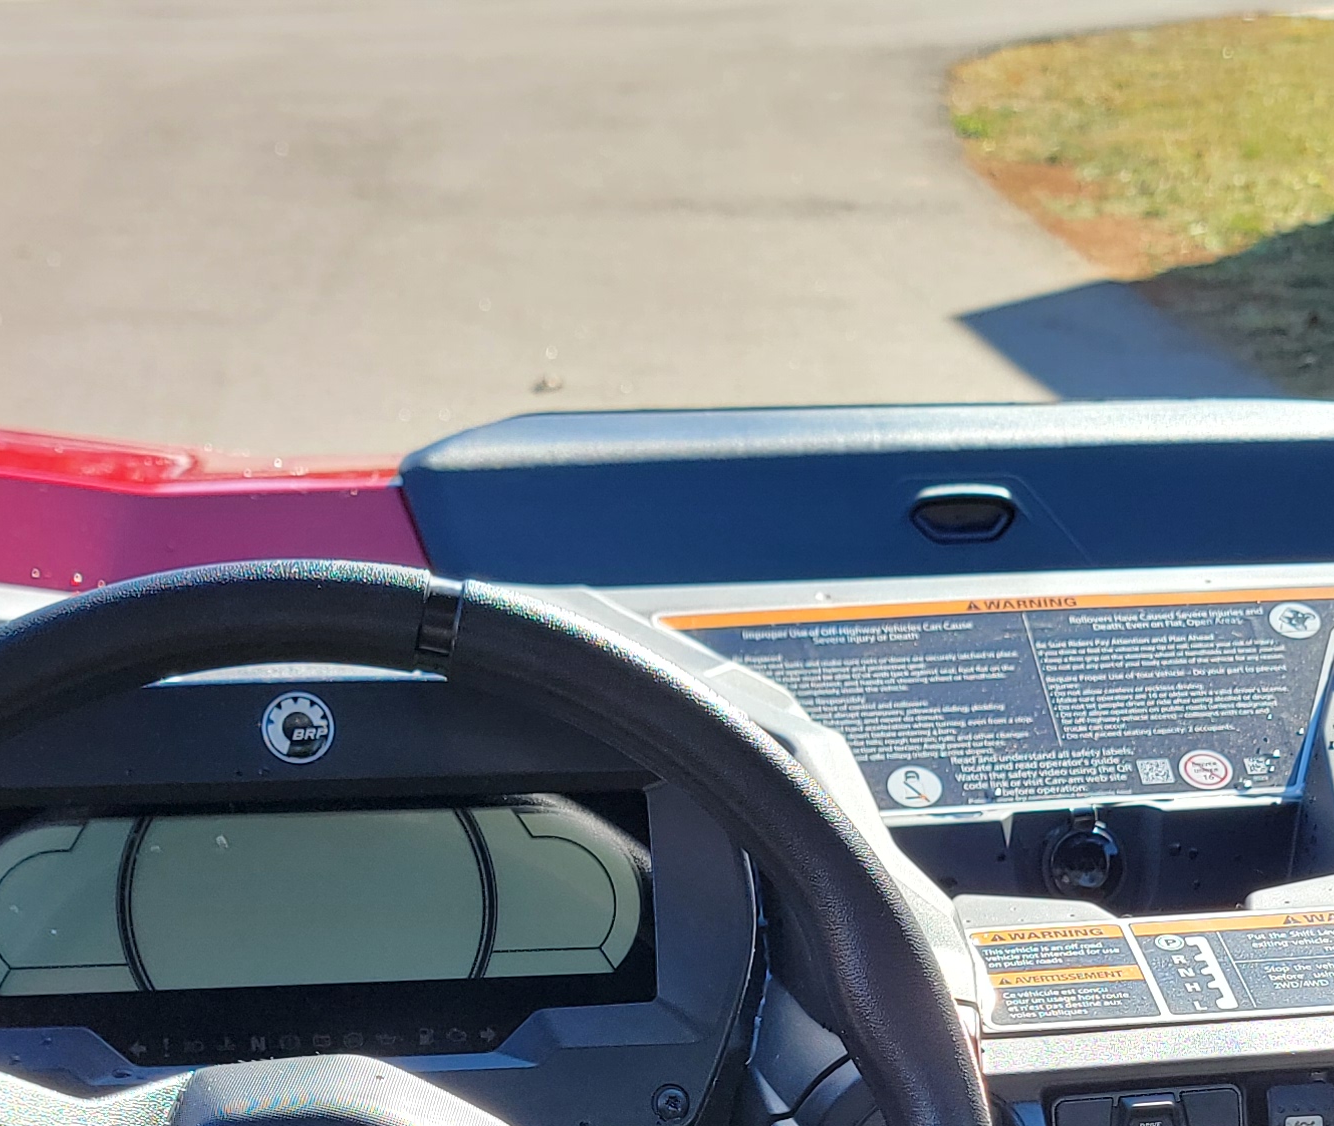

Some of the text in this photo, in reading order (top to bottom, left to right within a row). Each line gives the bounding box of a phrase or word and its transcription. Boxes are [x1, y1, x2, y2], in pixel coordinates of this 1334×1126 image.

[984, 598, 1077, 610] WARNING
[292, 727, 328, 740] BRP
[950, 756, 975, 765] Read
[979, 754, 997, 763] and
[999, 751, 1056, 762] understand
[1058, 750, 1069, 758] all
[1071, 748, 1100, 760] safety
[955, 763, 1132, 782] Watch the safety video using the QR
[961, 763, 992, 773] locate
[994, 762, 1013, 771] and
[1015, 760, 1037, 769] read
[963, 781, 989, 790] code
[1086, 774, 1107, 783] web
[1109, 772, 1127, 781] site
[1002, 786, 1034, 795] before
[1008, 928, 1104, 940] WARNING
[1247, 932, 1266, 940] Put
[1269, 931, 1287, 939] the
[1289, 929, 1315, 937] Shift
[1005, 946, 1040, 954] vehicle
[1080, 941, 1103, 949] road
[1168, 938, 1179, 946] P
[986, 954, 1020, 962] vehicle
[1041, 949, 1084, 958] intended
[1172, 955, 1187, 964] R
[1004, 959, 1035, 968] public
[1015, 970, 1123, 984] AVERTISSEMENT
[1178, 968, 1195, 977] N
[1185, 983, 1201, 992] H
[1006, 999, 1030, 1007] pour
[1047, 996, 1076, 1004] usage
[1100, 990, 1129, 999] route
[1193, 1001, 1207, 1010] L
[1010, 1007, 1088, 1019] voies publiques
